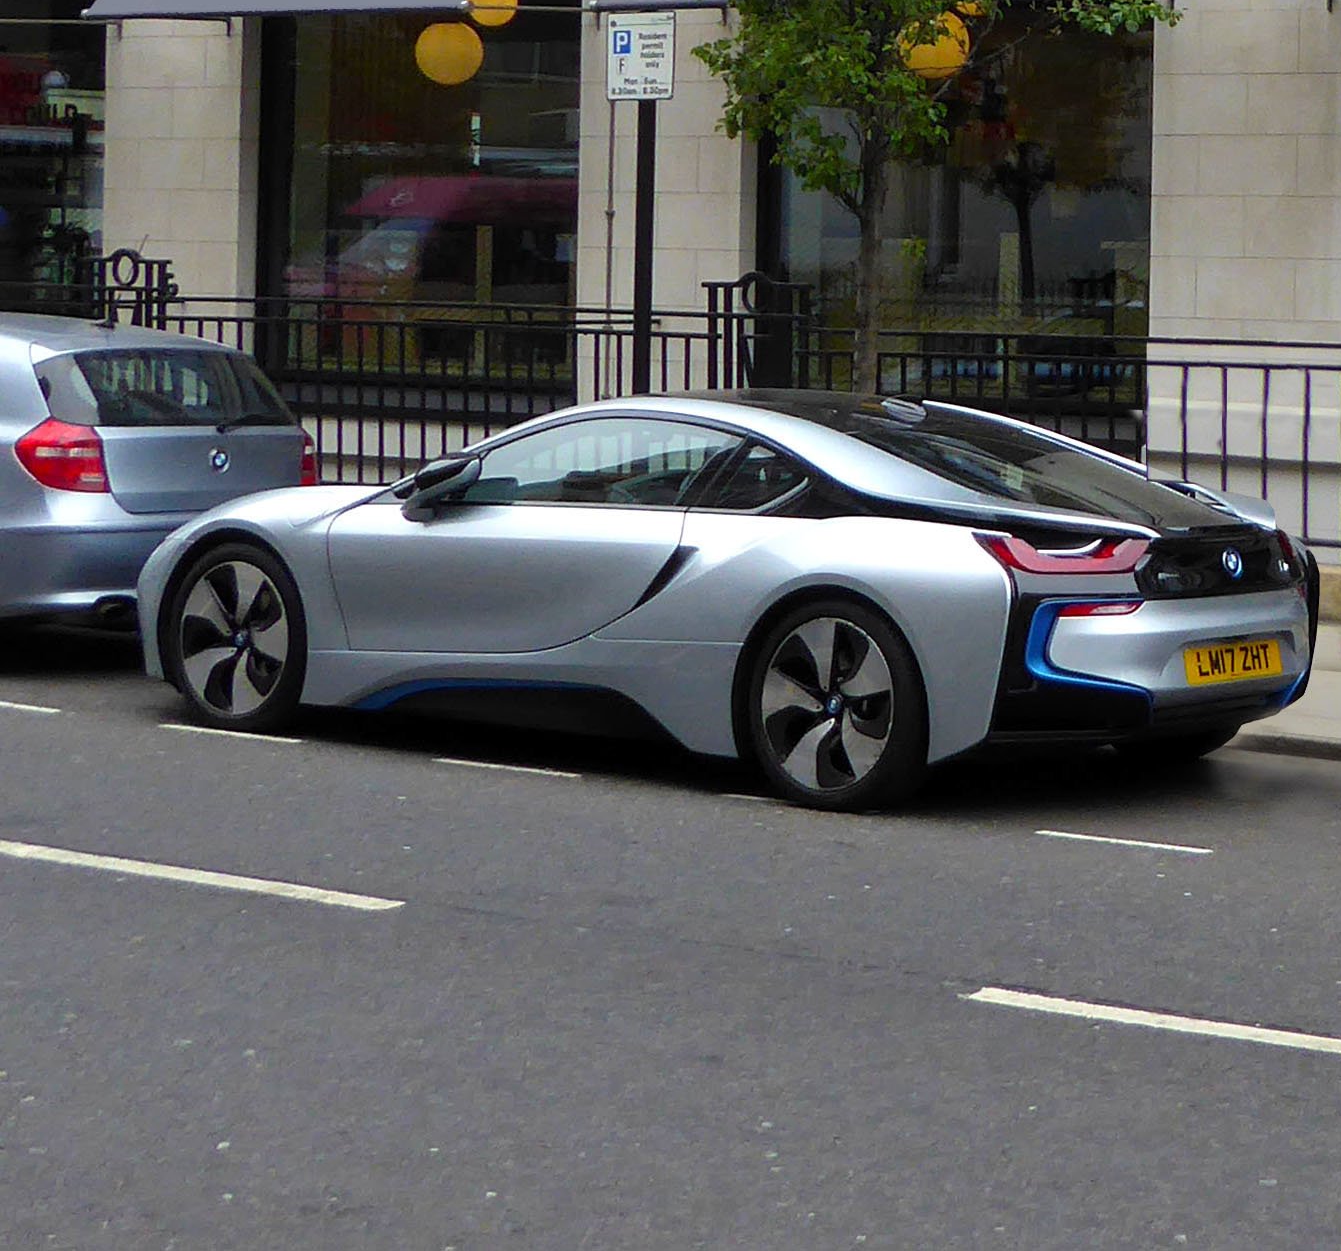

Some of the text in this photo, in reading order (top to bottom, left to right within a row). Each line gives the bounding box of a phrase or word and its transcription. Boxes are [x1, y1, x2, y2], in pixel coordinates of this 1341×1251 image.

[616, 32, 628, 53] P
[1196, 643, 1269, 677] LM17 ZHT
